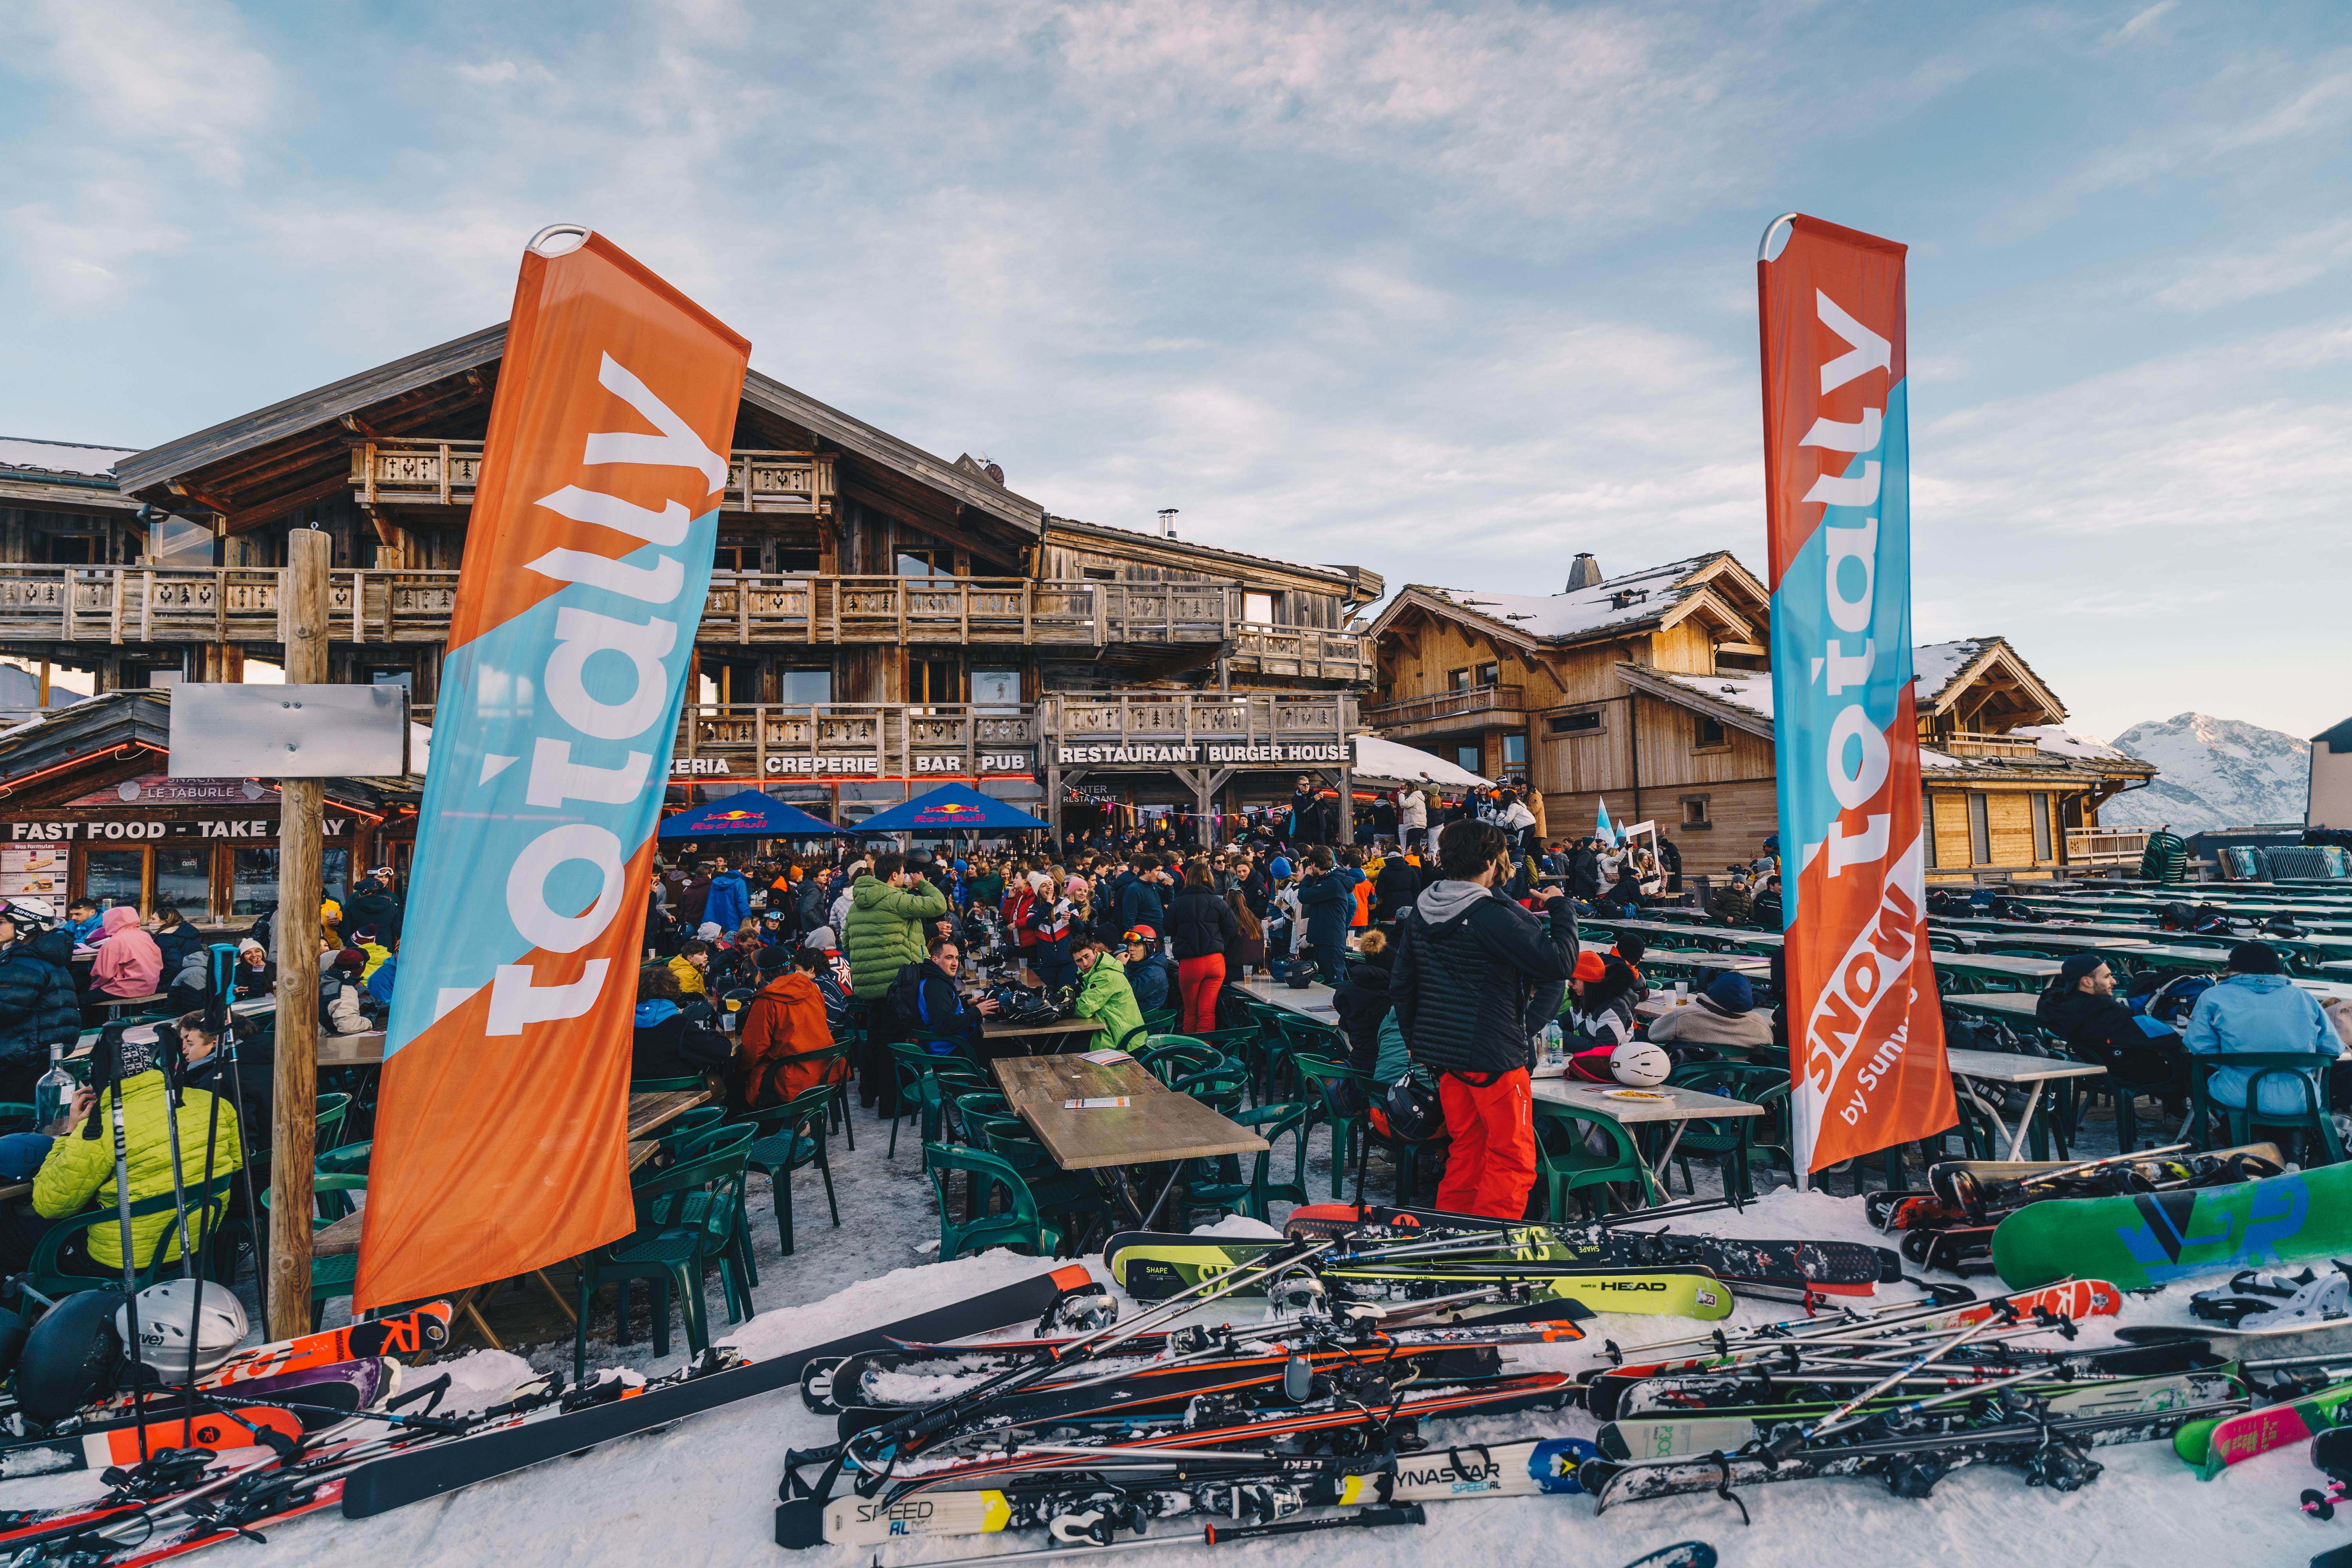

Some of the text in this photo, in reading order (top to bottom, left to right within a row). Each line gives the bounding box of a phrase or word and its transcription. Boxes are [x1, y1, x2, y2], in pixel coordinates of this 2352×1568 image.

[1798, 288, 1892, 878] totally
[434, 350, 728, 1036] totally
[1060, 746, 1200, 763] RESTAURANT
[1209, 745, 1350, 761] BURGER HOUSE
[766, 757, 878, 773] CREPERIE
[916, 756, 960, 771] BAR
[982, 755, 1025, 770] PUB
[149, 788, 234, 797] LE TABURLE
[691, 821, 730, 830] Red
[914, 813, 985, 823] Red Bull
[12, 822, 78, 840] FAST
[88, 822, 166, 839] FOOD
[198, 820, 267, 837] TAKE
[13, 907, 43, 921] SINNER
[1807, 882, 1916, 1095] SNOW
[1840, 1089, 1867, 1126] by
[1601, 1282, 1667, 1291] HEAD
[1171, 1304, 1192, 1318] Altitude
[139, 1333, 165, 1346] vex
[336, 1330, 345, 1363] ROSSIGNOL
[1283, 1460, 1323, 1469] LEKI
[1395, 1463, 1500, 1487] YNASAR
[1452, 1481, 1489, 1494] SPEED
